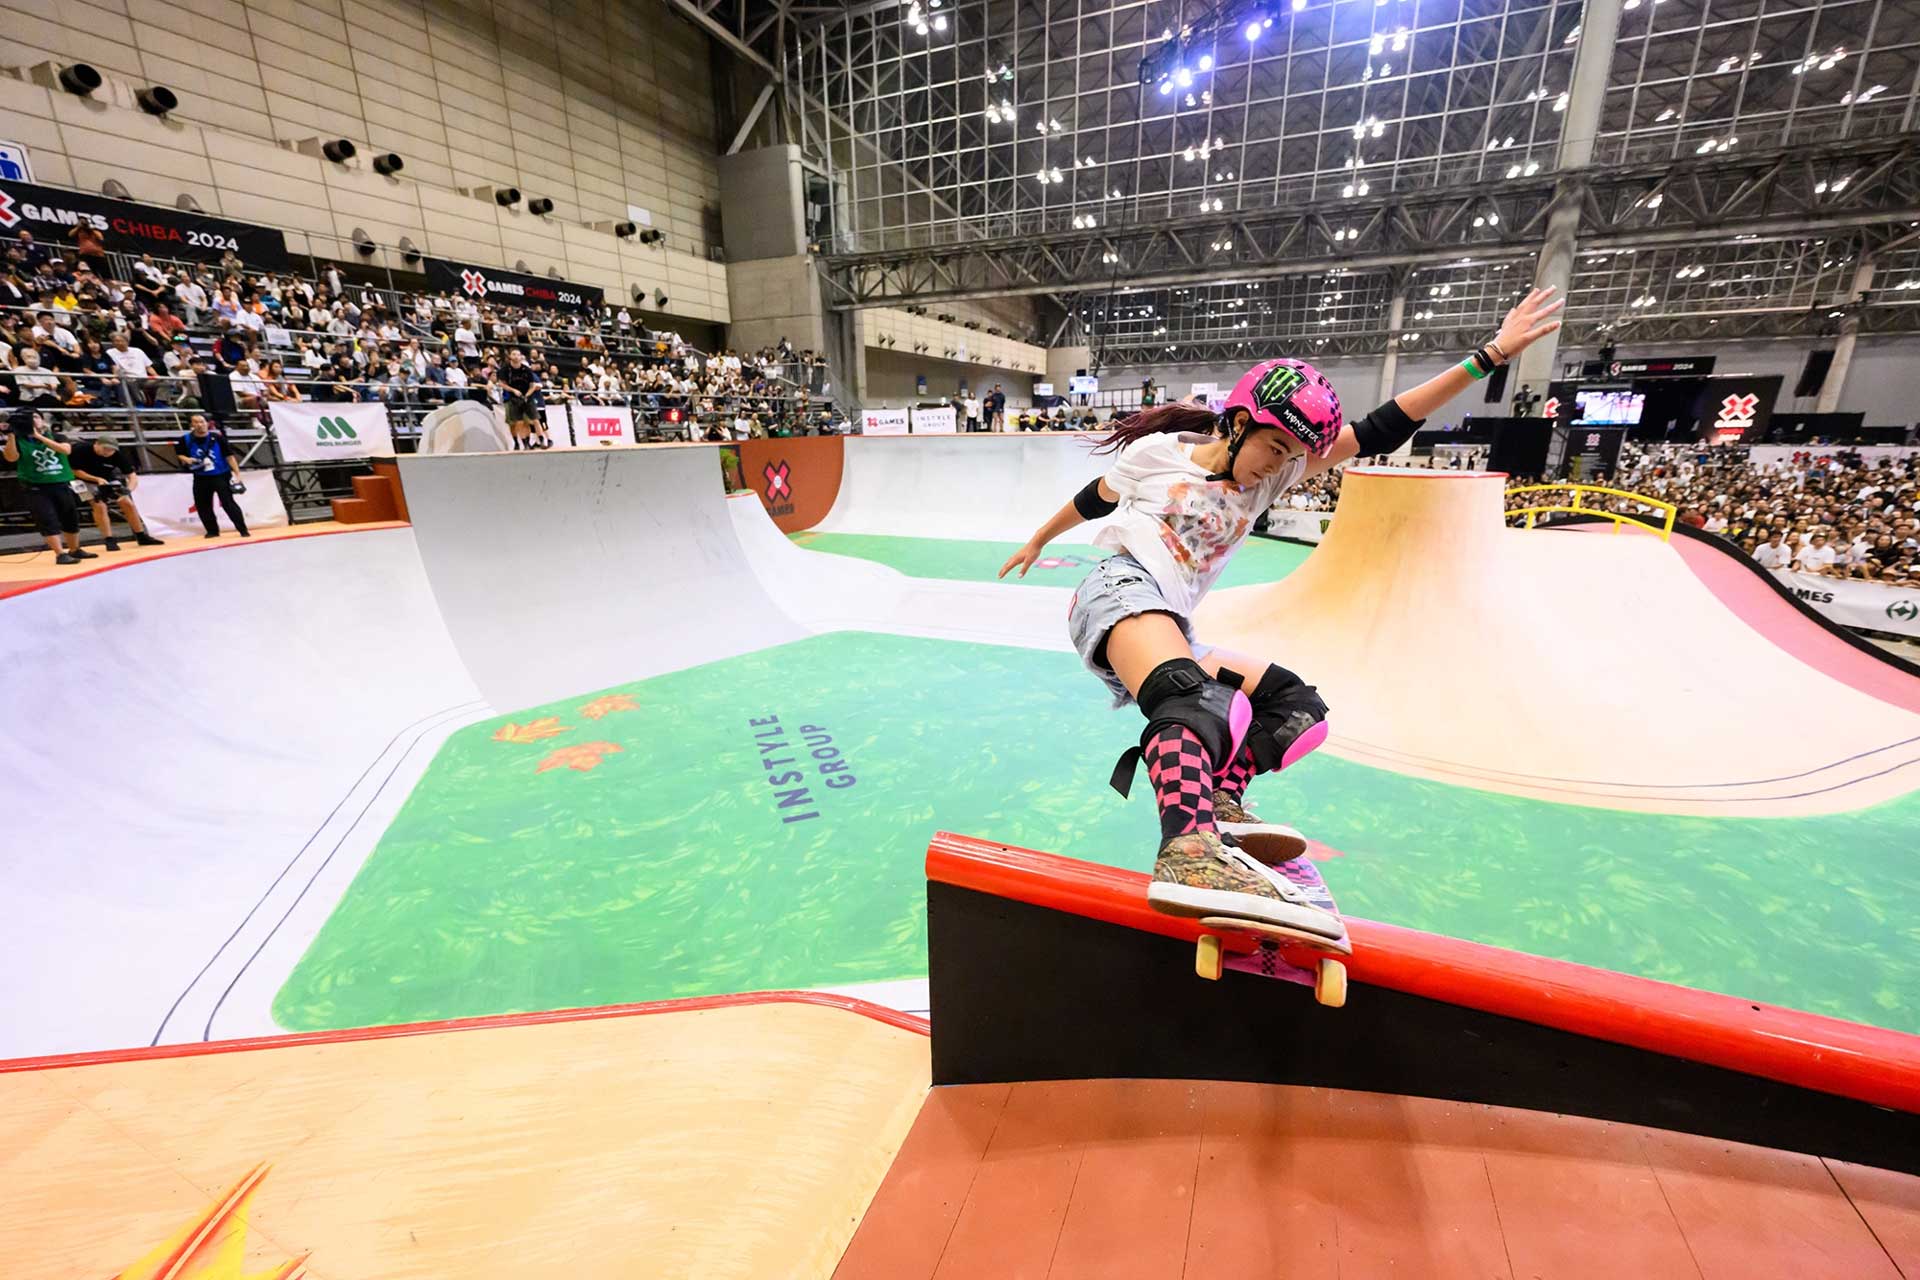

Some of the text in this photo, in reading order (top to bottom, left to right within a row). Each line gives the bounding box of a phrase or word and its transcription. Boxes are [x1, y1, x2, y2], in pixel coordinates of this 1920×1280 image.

[112, 217, 183, 242] CHIBA
[186, 230, 239, 251] 2024
[487, 280, 525, 296] GAMES
[526, 287, 557, 300] CHIBA
[558, 291, 582, 305] 2024
[1283, 409, 1319, 442] MONSTER
[749, 715, 820, 824] INSTYLE
[799, 725, 857, 789] GROUP
